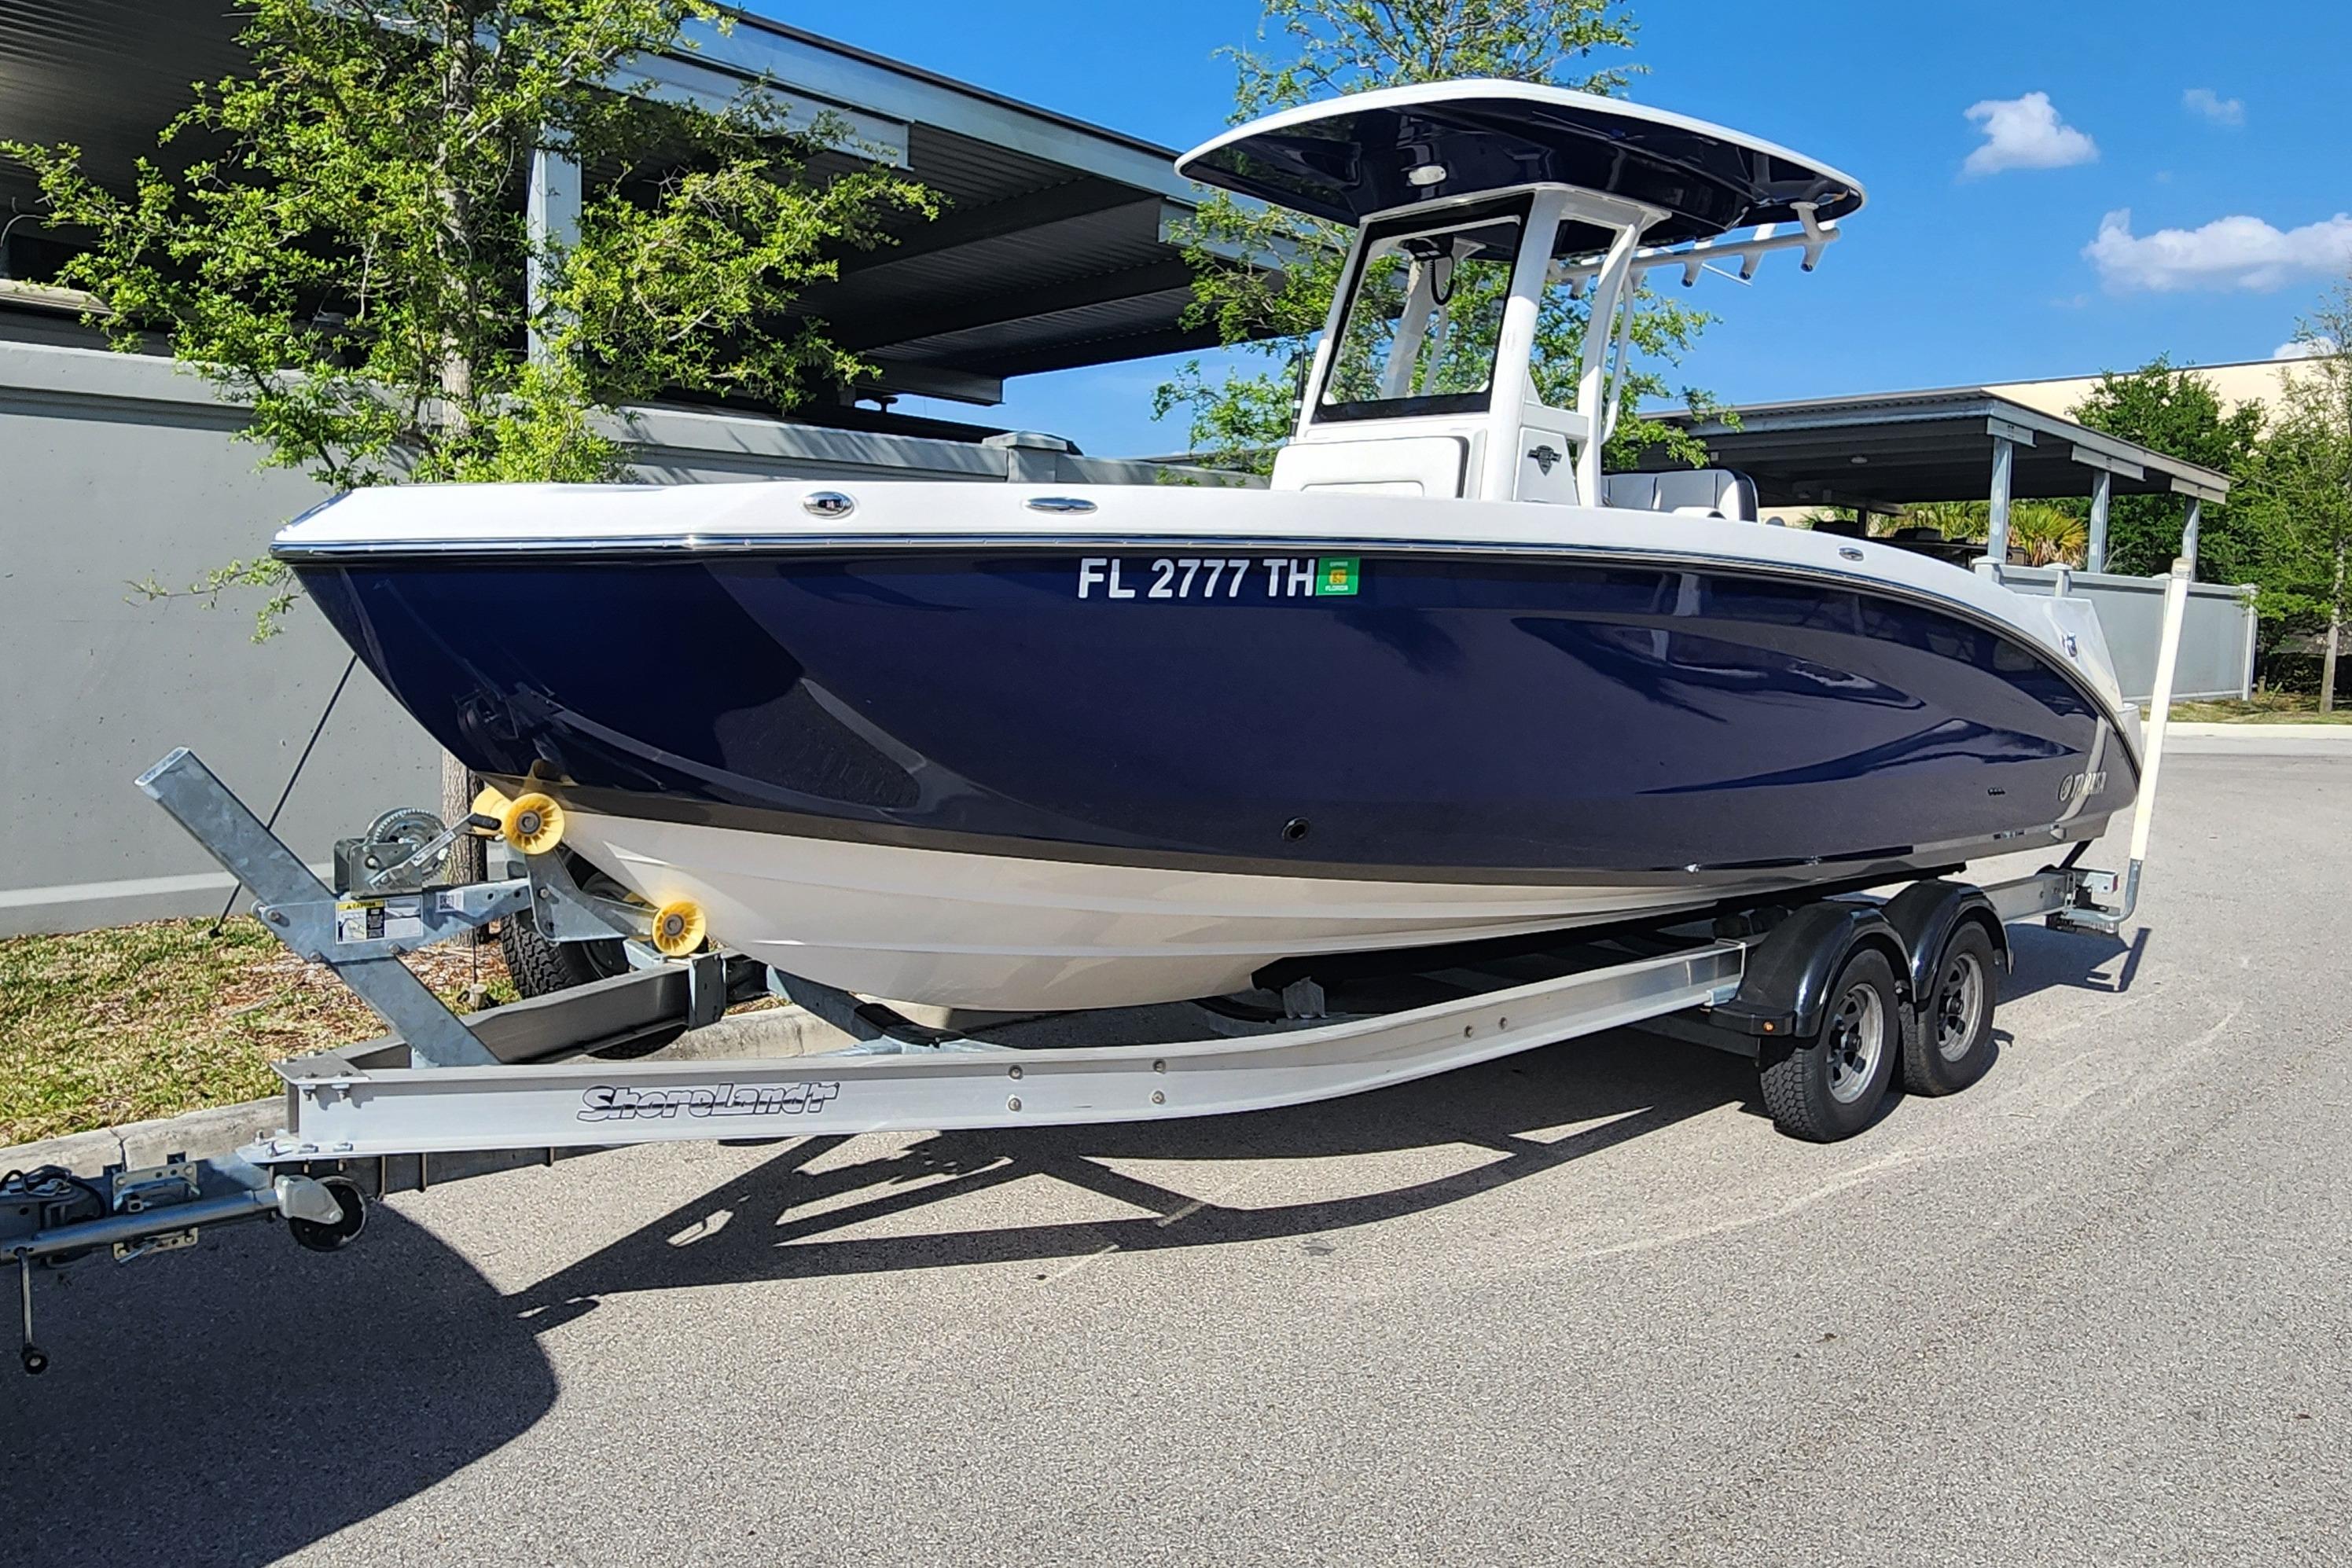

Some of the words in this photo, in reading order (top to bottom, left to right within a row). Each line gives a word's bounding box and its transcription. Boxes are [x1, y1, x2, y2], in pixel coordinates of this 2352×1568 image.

[1078, 557, 1136, 598] FL
[1148, 558, 1251, 598] 2777
[1262, 558, 1316, 597] TH
